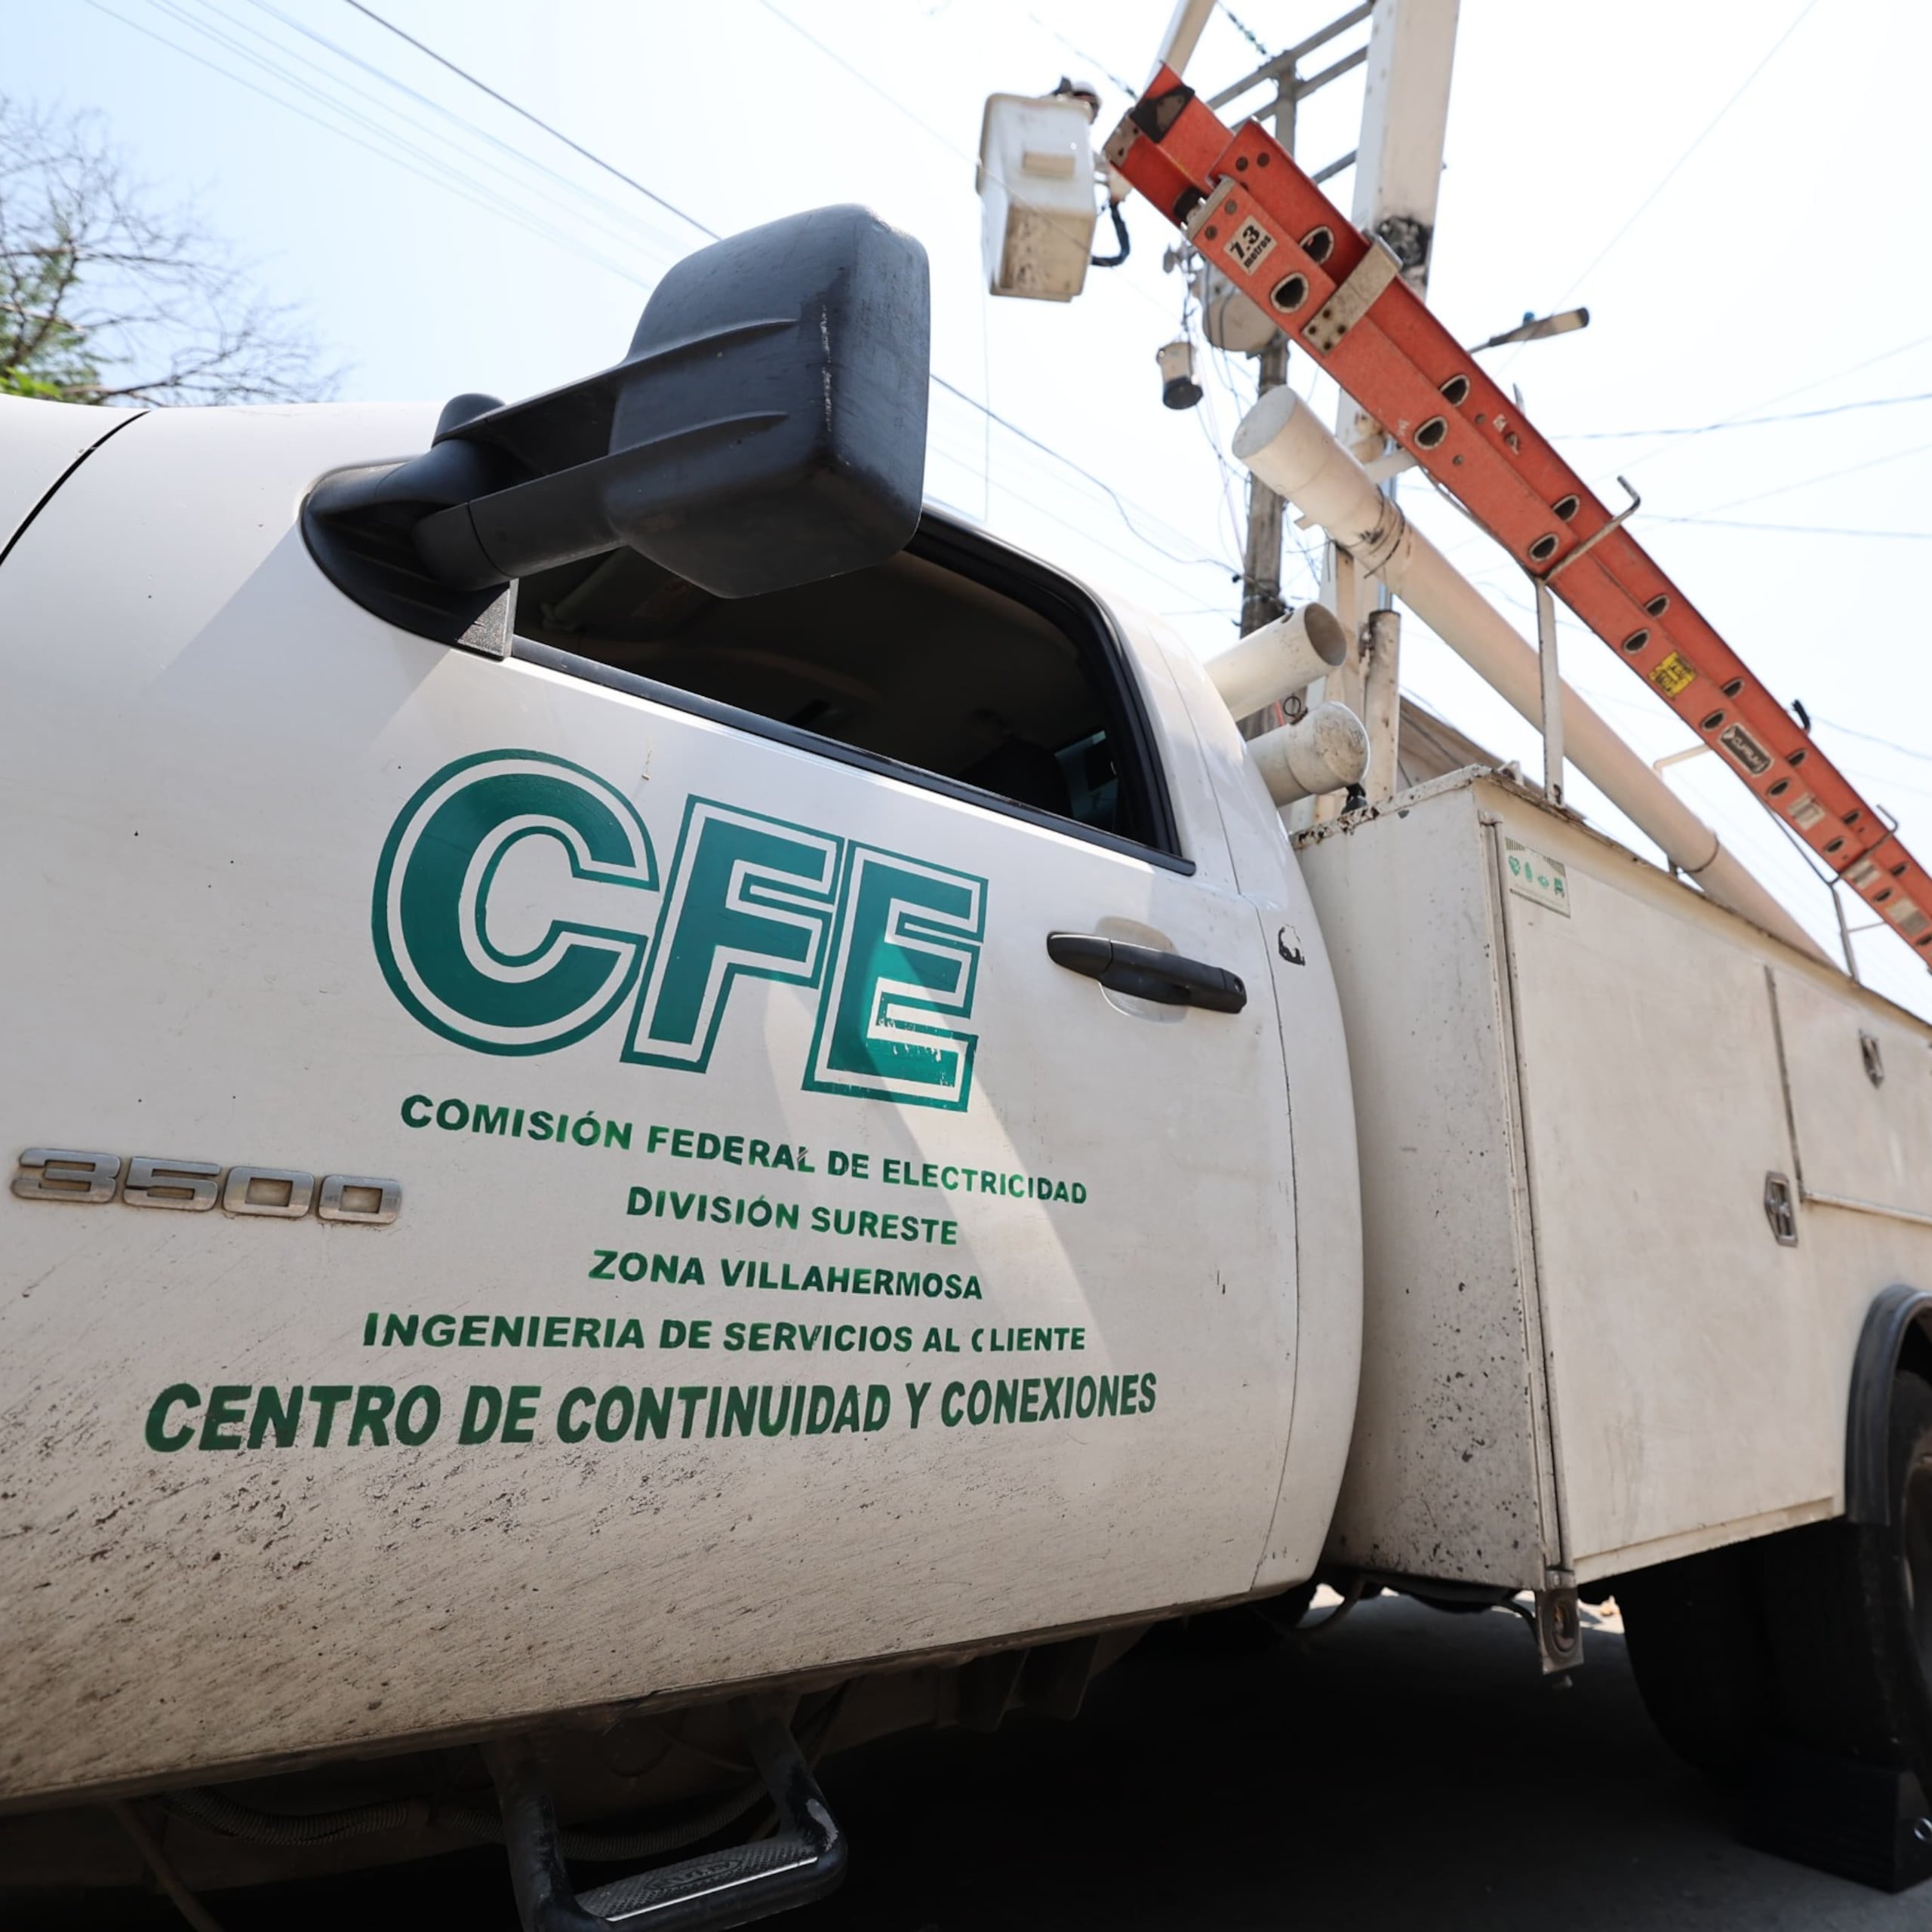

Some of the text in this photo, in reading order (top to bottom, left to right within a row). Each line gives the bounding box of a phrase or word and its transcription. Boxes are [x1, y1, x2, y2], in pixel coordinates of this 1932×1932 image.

[1229, 224, 1260, 260] 7.3
[1243, 234, 1272, 269] metros
[370, 747, 990, 1114] CFE
[400, 1094, 1088, 1205] COMISIÓN FEDERAL DE ELECTRICIDAD
[11, 1146, 404, 1225] 3500
[626, 1186, 958, 1246] DIVISIÓN SURESTE
[587, 1248, 983, 1300] ZONA VILLAHERMOSA
[362, 1311, 1086, 1353] INGENIERIA DE SERVICIOS AL CLIENTE
[145, 1372, 1157, 1451] CENTRO DE CONTINUIDAD Y CONEXIONES
